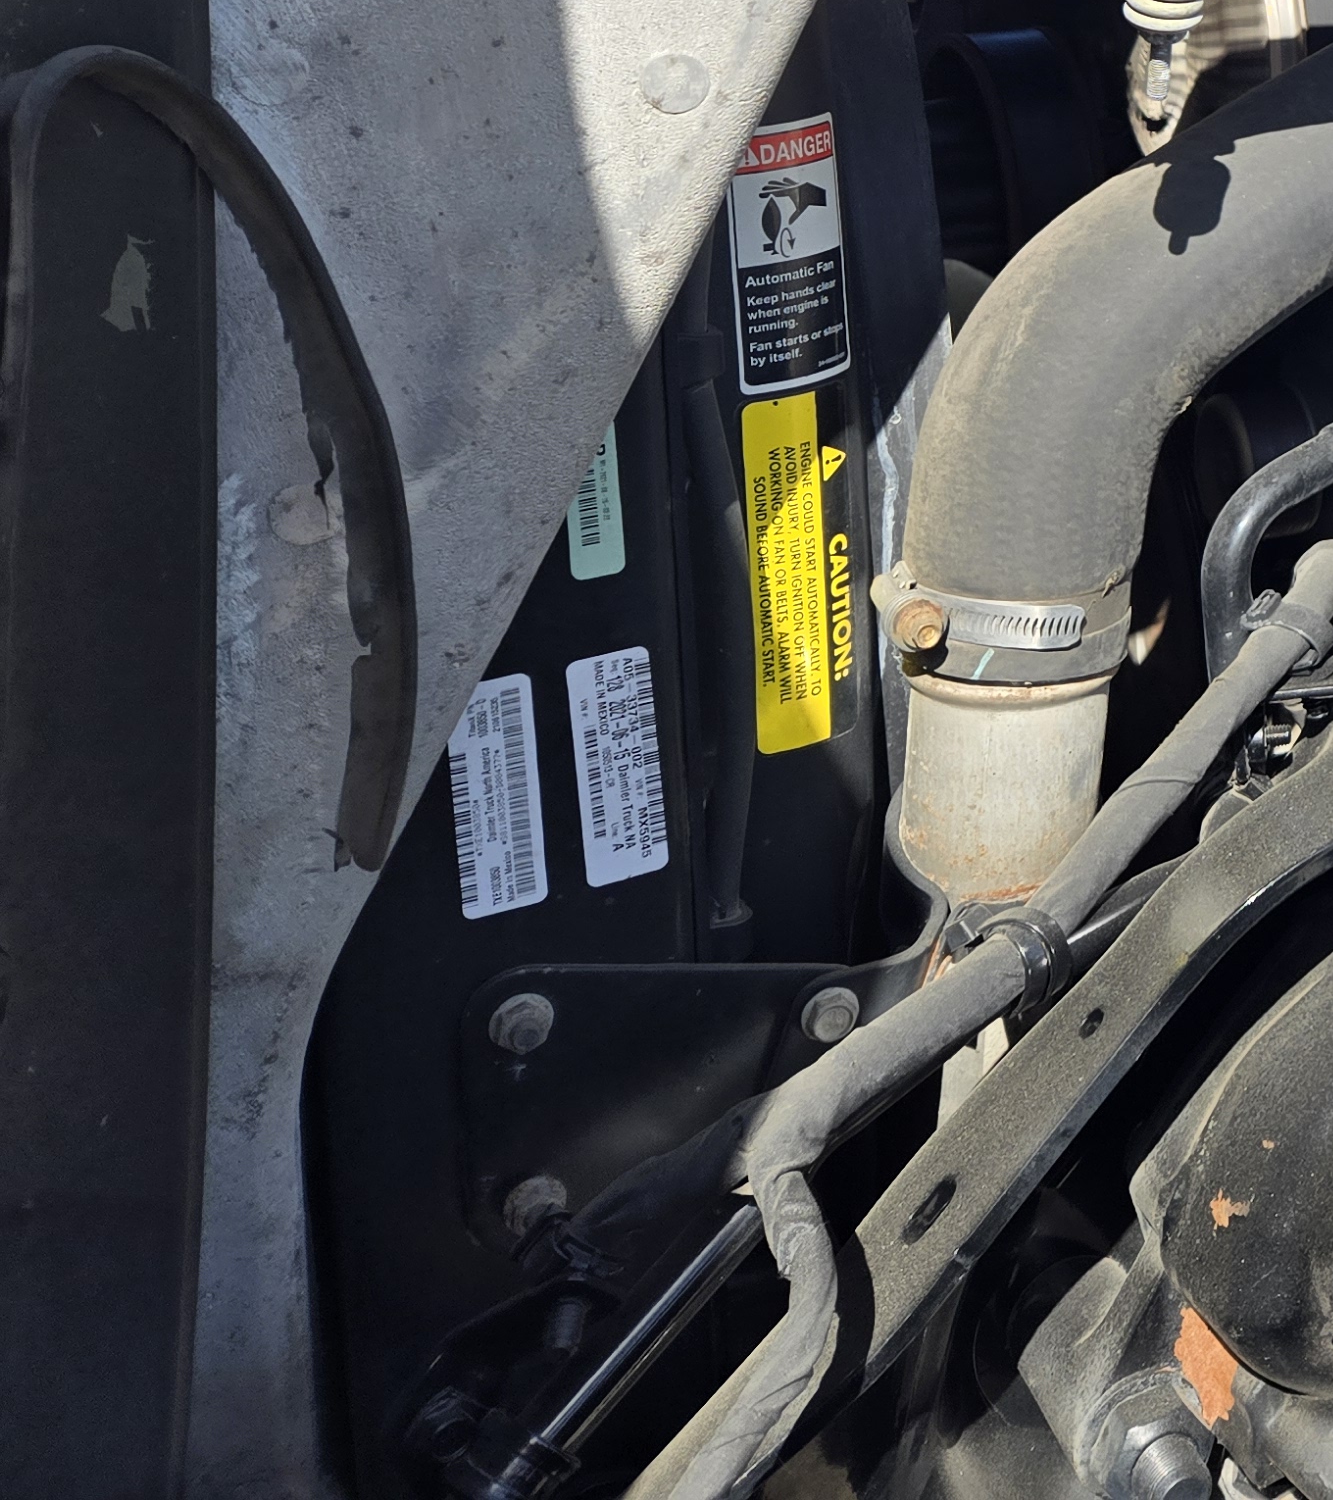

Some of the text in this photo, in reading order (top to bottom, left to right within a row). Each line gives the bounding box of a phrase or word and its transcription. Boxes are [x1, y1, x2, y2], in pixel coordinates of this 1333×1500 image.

[760, 130, 831, 164] DANGER
[745, 260, 834, 288] Automatic Fan
[747, 279, 836, 306] Keep hands clear
[747, 295, 829, 320] when engine is
[748, 319, 799, 334] running.
[749, 341, 772, 352] Fan
[775, 334, 809, 348] starts
[810, 330, 822, 340] or
[750, 356, 766, 367] by
[769, 348, 803, 363] itself.
[784, 446, 798, 484] AVOID
[789, 538, 802, 571] TURN
[800, 441, 822, 696] ENGINE COULD START AUTOMATICALLY. TO
[753, 476, 775, 687] SOUND BEFORE AUTOMATIC START.
[768, 447, 793, 705] WORKING ON FAN OR BELTS. ALARM WILL
[791, 574, 805, 632] IGNITION
[829, 533, 853, 682] CAUTION:
[794, 635, 805, 657] OFF
[593, 660, 605, 688] MADE
[606, 675, 625, 693] 128
[795, 661, 808, 701] WHEN
[596, 689, 606, 699] IN
[597, 701, 610, 736] MEXICO
[481, 747, 491, 775] America
[617, 764, 631, 802] Daimler
[484, 795, 494, 815] Truck
[622, 804, 636, 833] Truck
[624, 833, 637, 850] NA
[638, 807, 652, 858] MX5945
[612, 843, 624, 852] A
[504, 850, 513, 875] Mexico
